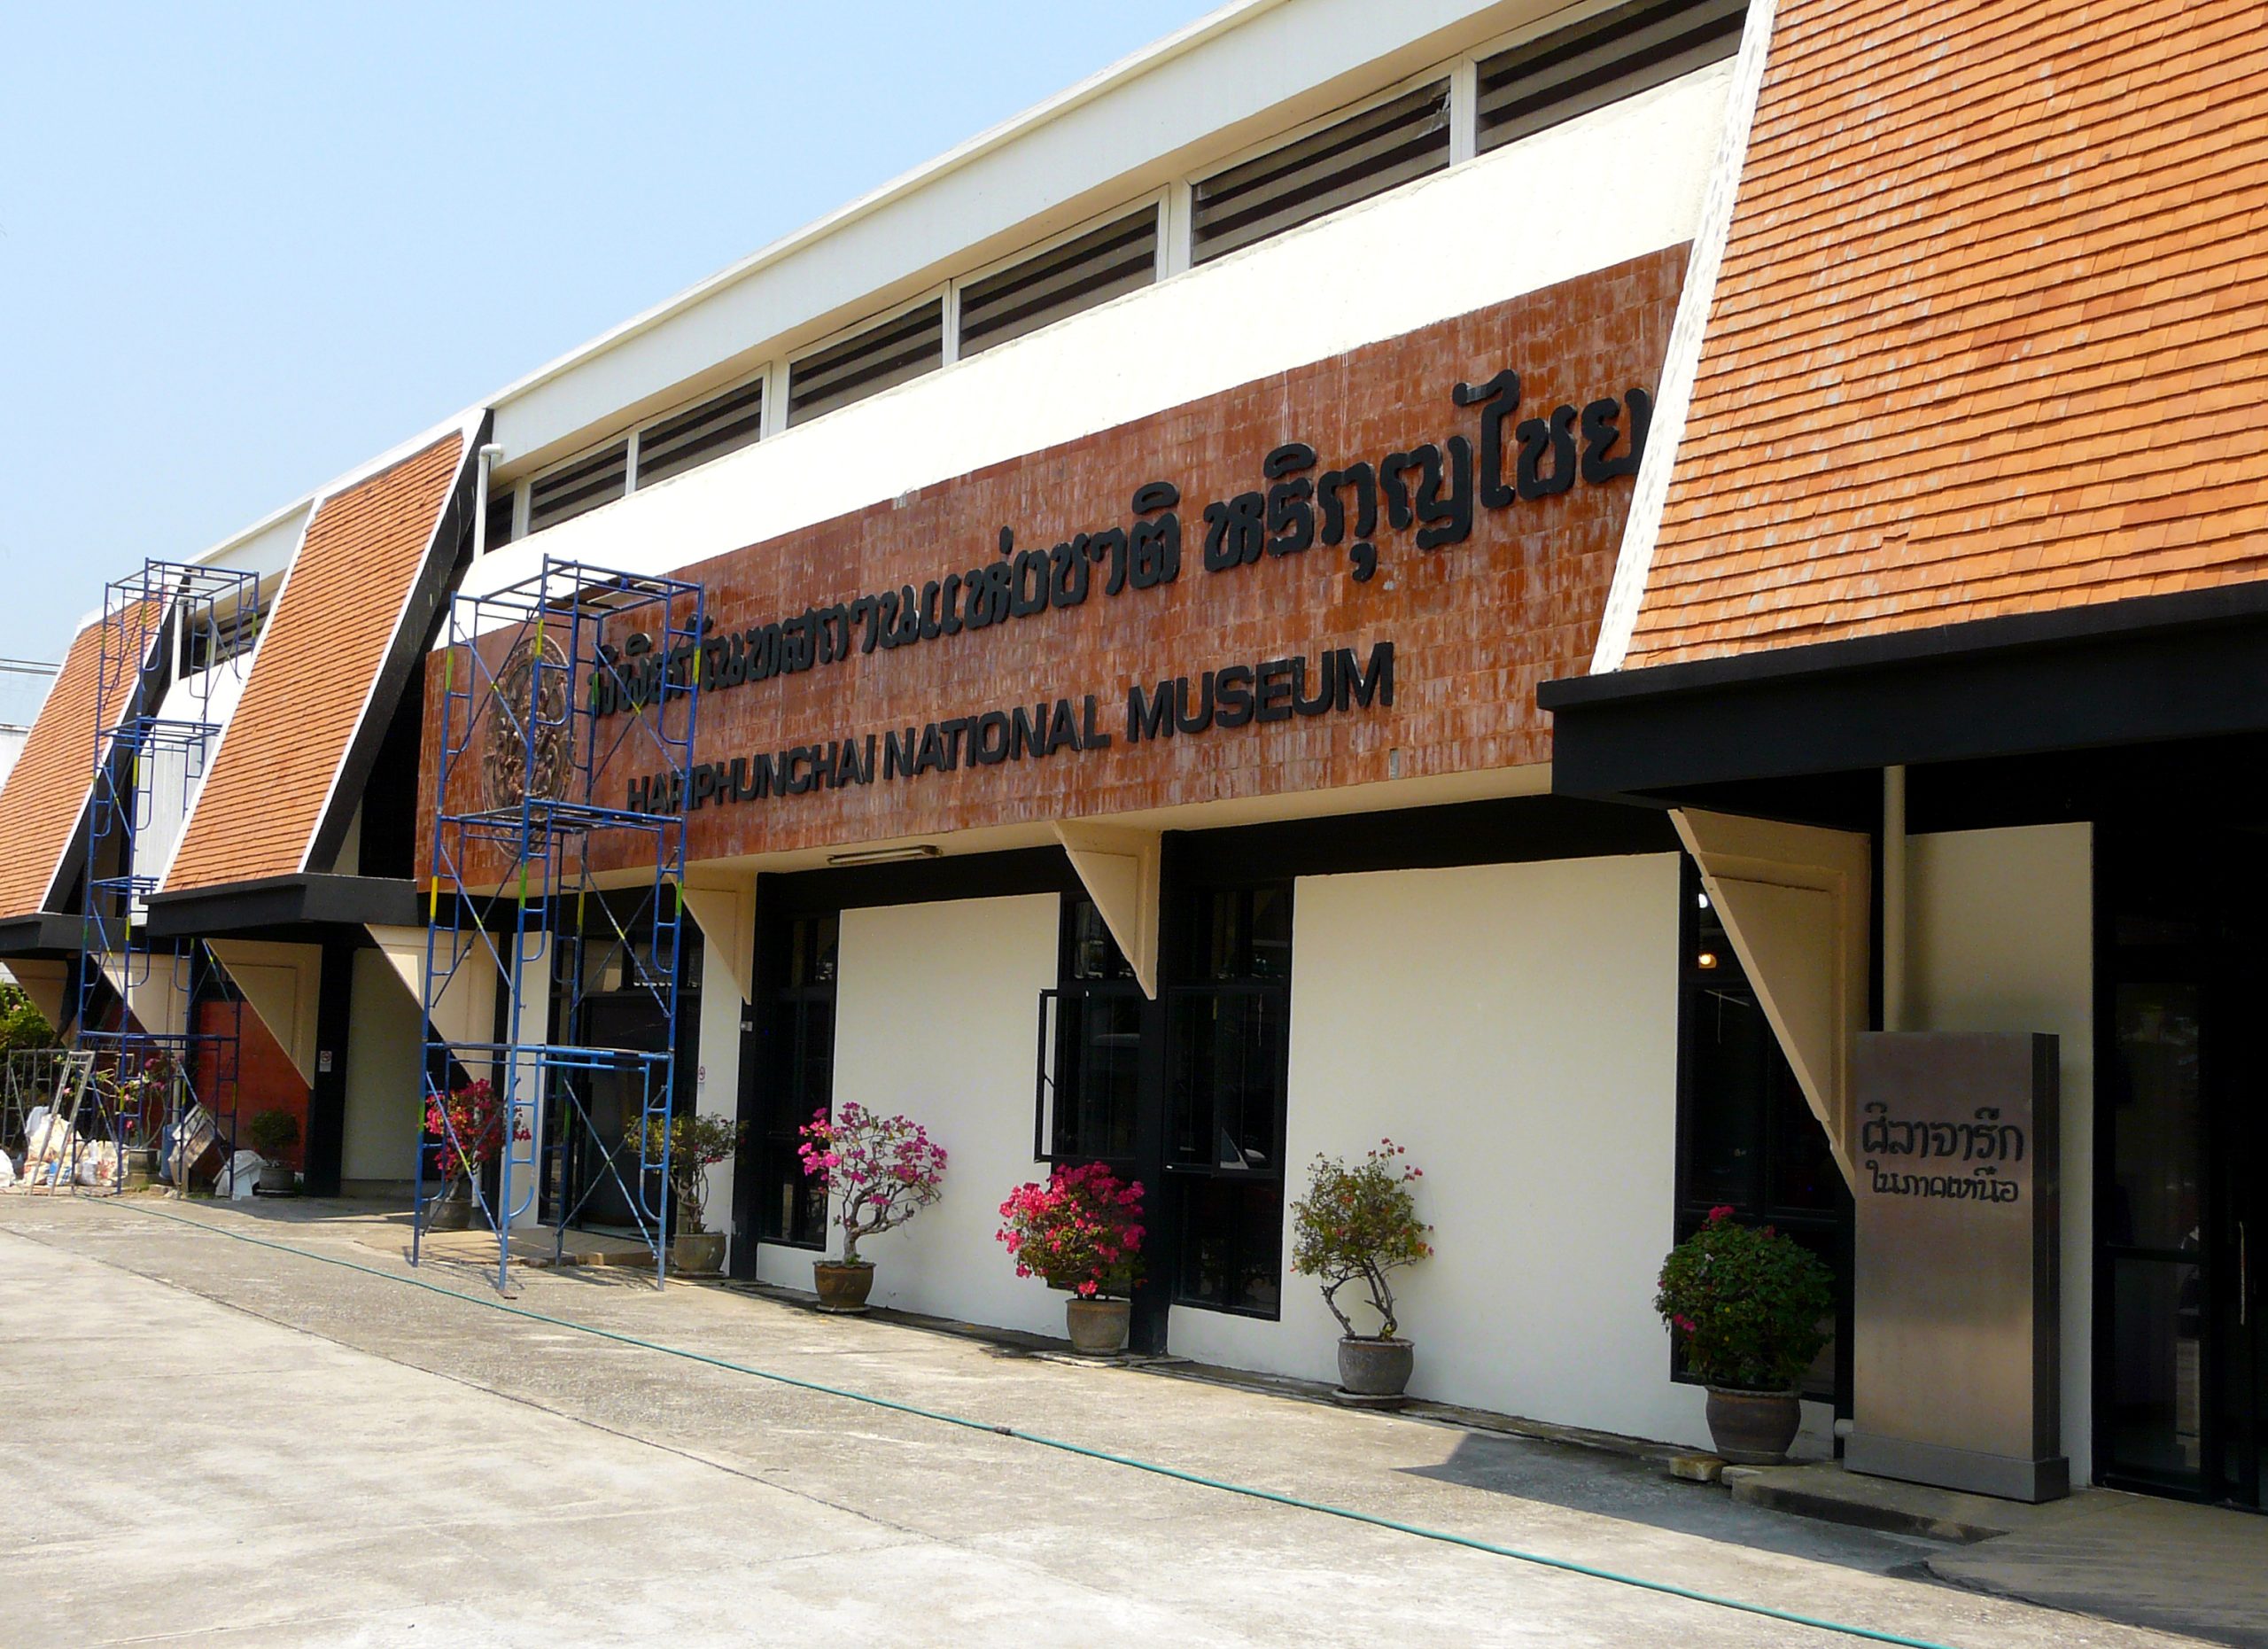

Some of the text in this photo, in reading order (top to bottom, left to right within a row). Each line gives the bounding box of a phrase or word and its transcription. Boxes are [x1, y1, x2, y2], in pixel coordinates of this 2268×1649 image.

[1203, 369, 1653, 582] หริภุญไชย
[883, 695, 1111, 780] NATIONAL
[1126, 642, 1394, 743] MUSEUM
[1861, 1101, 2025, 1162] ศิลาจารึก
[1865, 1159, 2019, 1202] ในภาคเหนือ
